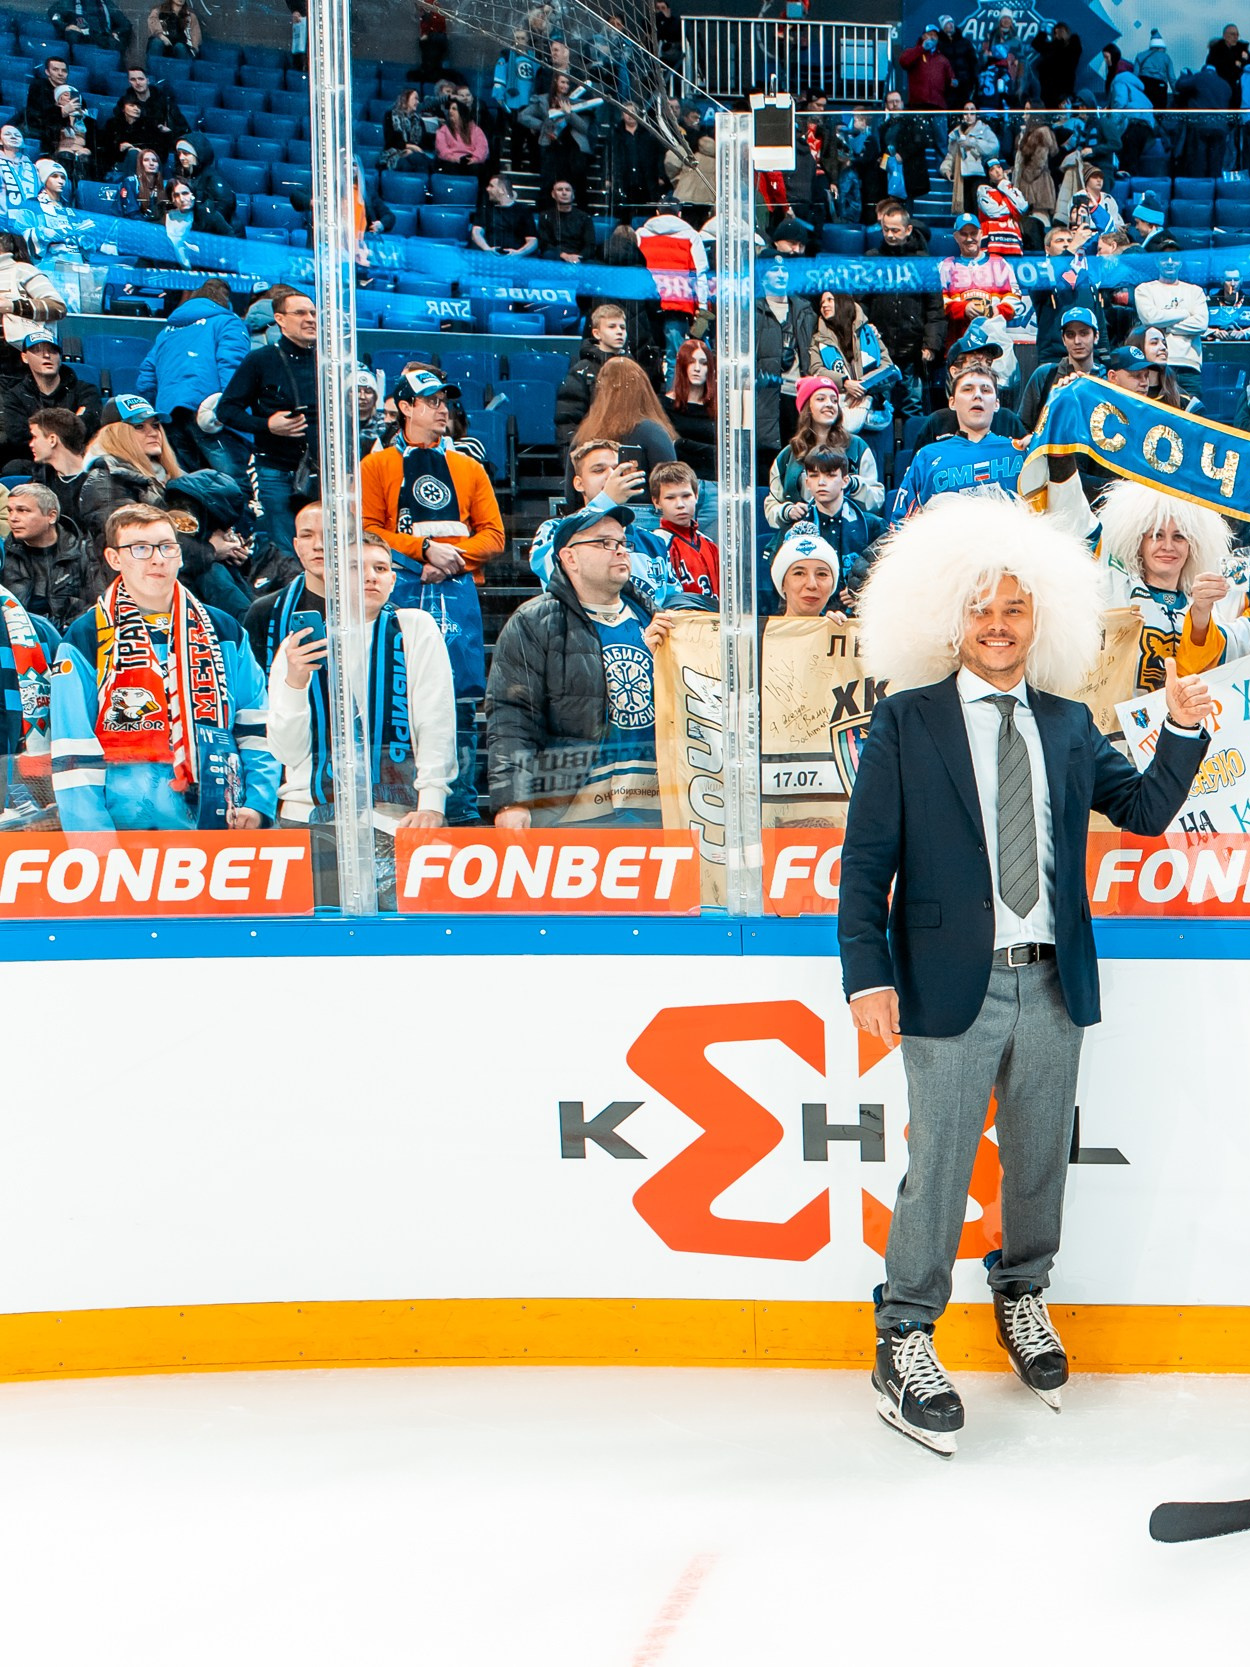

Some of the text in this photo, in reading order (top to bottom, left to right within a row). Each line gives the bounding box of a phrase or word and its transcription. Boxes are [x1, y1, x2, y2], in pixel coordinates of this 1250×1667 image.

[773, 771, 823, 788] 17.07.
[1, 847, 306, 905] FONBET
[403, 844, 696, 901] FONBET
